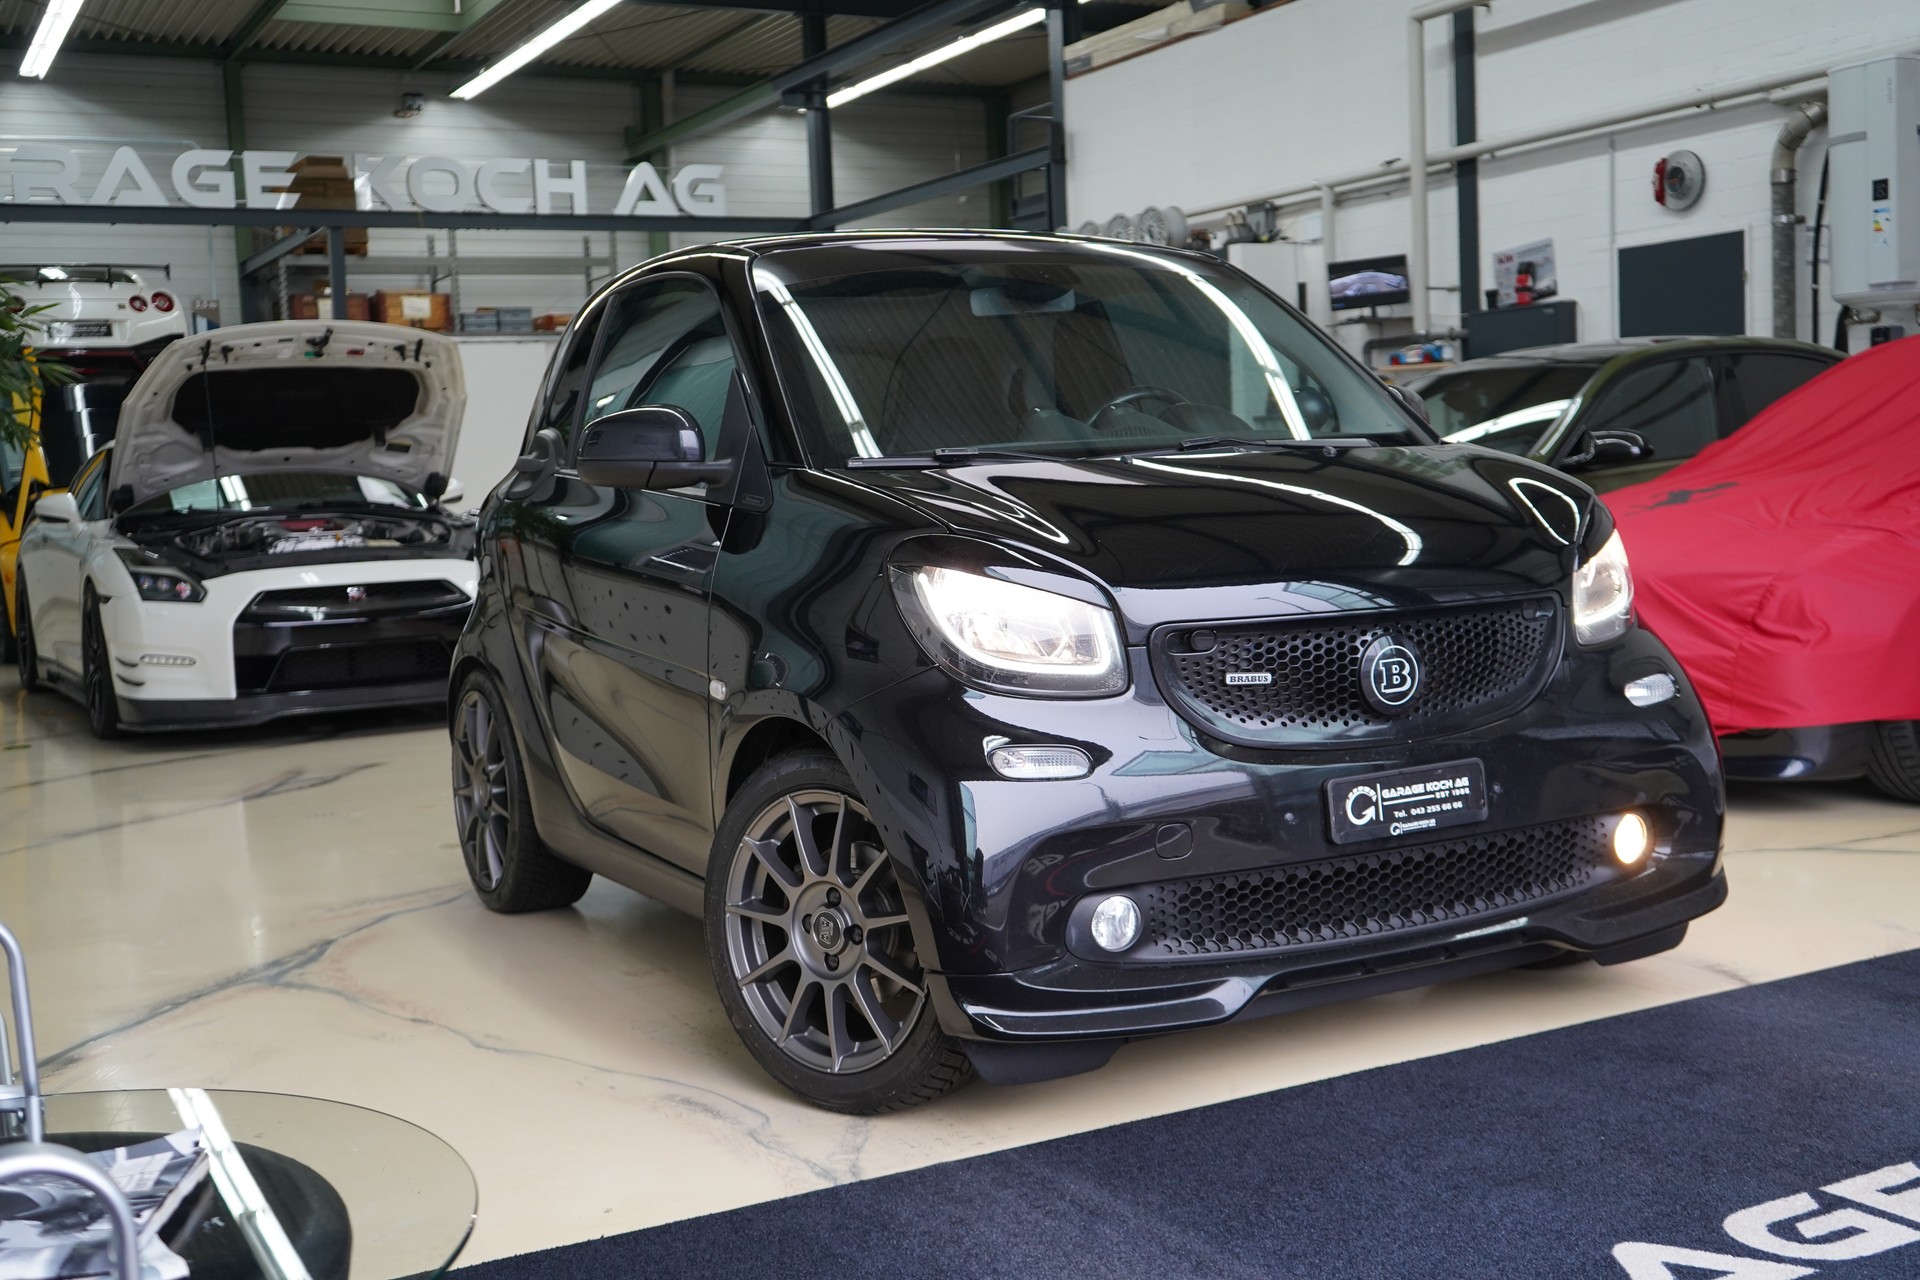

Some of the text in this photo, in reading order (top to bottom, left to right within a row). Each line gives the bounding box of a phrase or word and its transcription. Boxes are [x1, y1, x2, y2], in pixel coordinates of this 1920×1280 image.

[9, 145, 727, 217] RAGE KOCH AG
[1229, 674, 1269, 683] BRABUS
[1382, 776, 1469, 799] GARAGE KOCH AG
[1435, 790, 1450, 799] EST
[1393, 810, 1408, 818] Tel.
[1410, 807, 1425, 816] 043
[1426, 804, 1441, 813] 255
